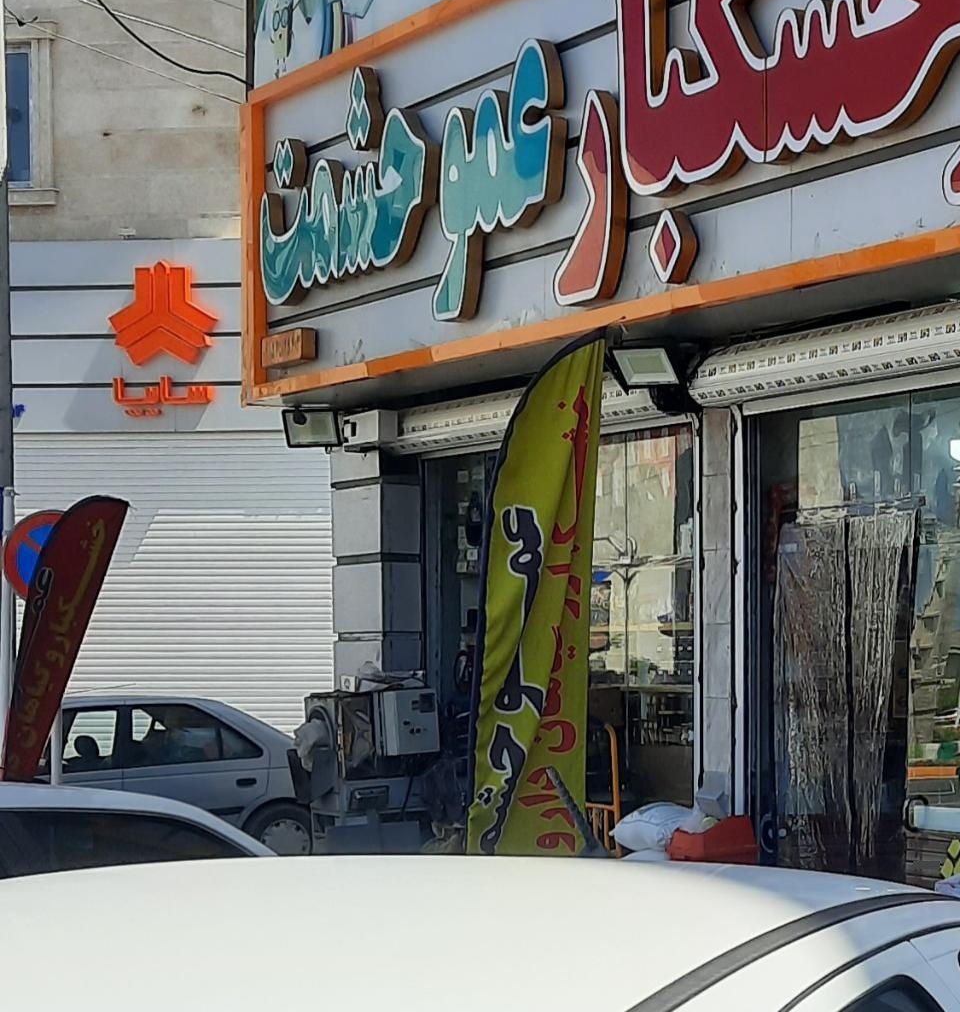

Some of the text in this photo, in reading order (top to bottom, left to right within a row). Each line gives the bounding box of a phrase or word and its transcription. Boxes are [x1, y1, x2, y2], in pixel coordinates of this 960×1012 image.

[260, 67, 427, 305] حشمت
[433, 39, 554, 320] عمو
[112, 376, 213, 418] سایپا
[476, 723, 528, 855] حشم
